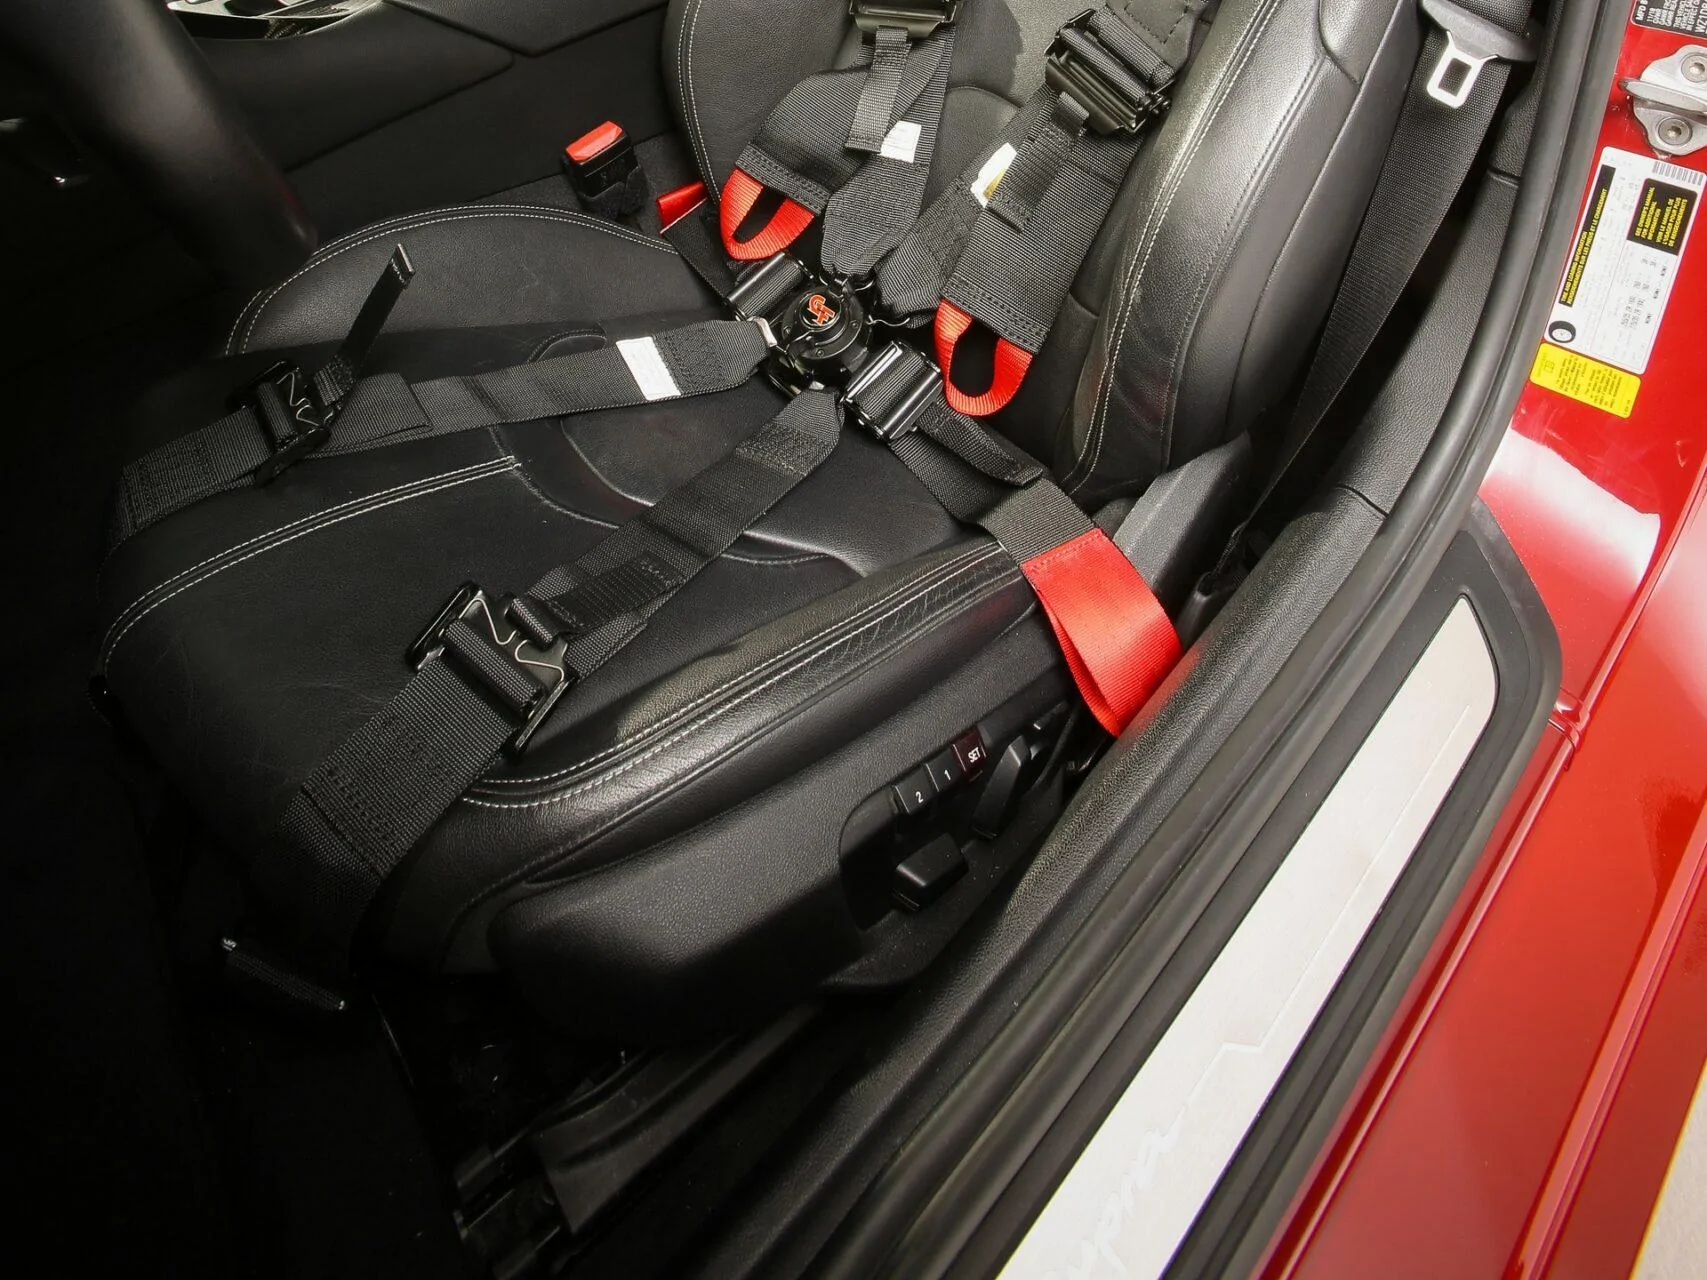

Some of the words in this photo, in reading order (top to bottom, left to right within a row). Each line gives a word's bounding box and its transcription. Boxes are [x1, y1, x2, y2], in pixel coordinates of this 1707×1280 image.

[1636, 5, 1646, 20] MFD
[1688, 4, 1698, 24] EFFECT
[967, 747, 982, 763] SET
[944, 769, 952, 781] 1
[915, 791, 924, 804] 2
